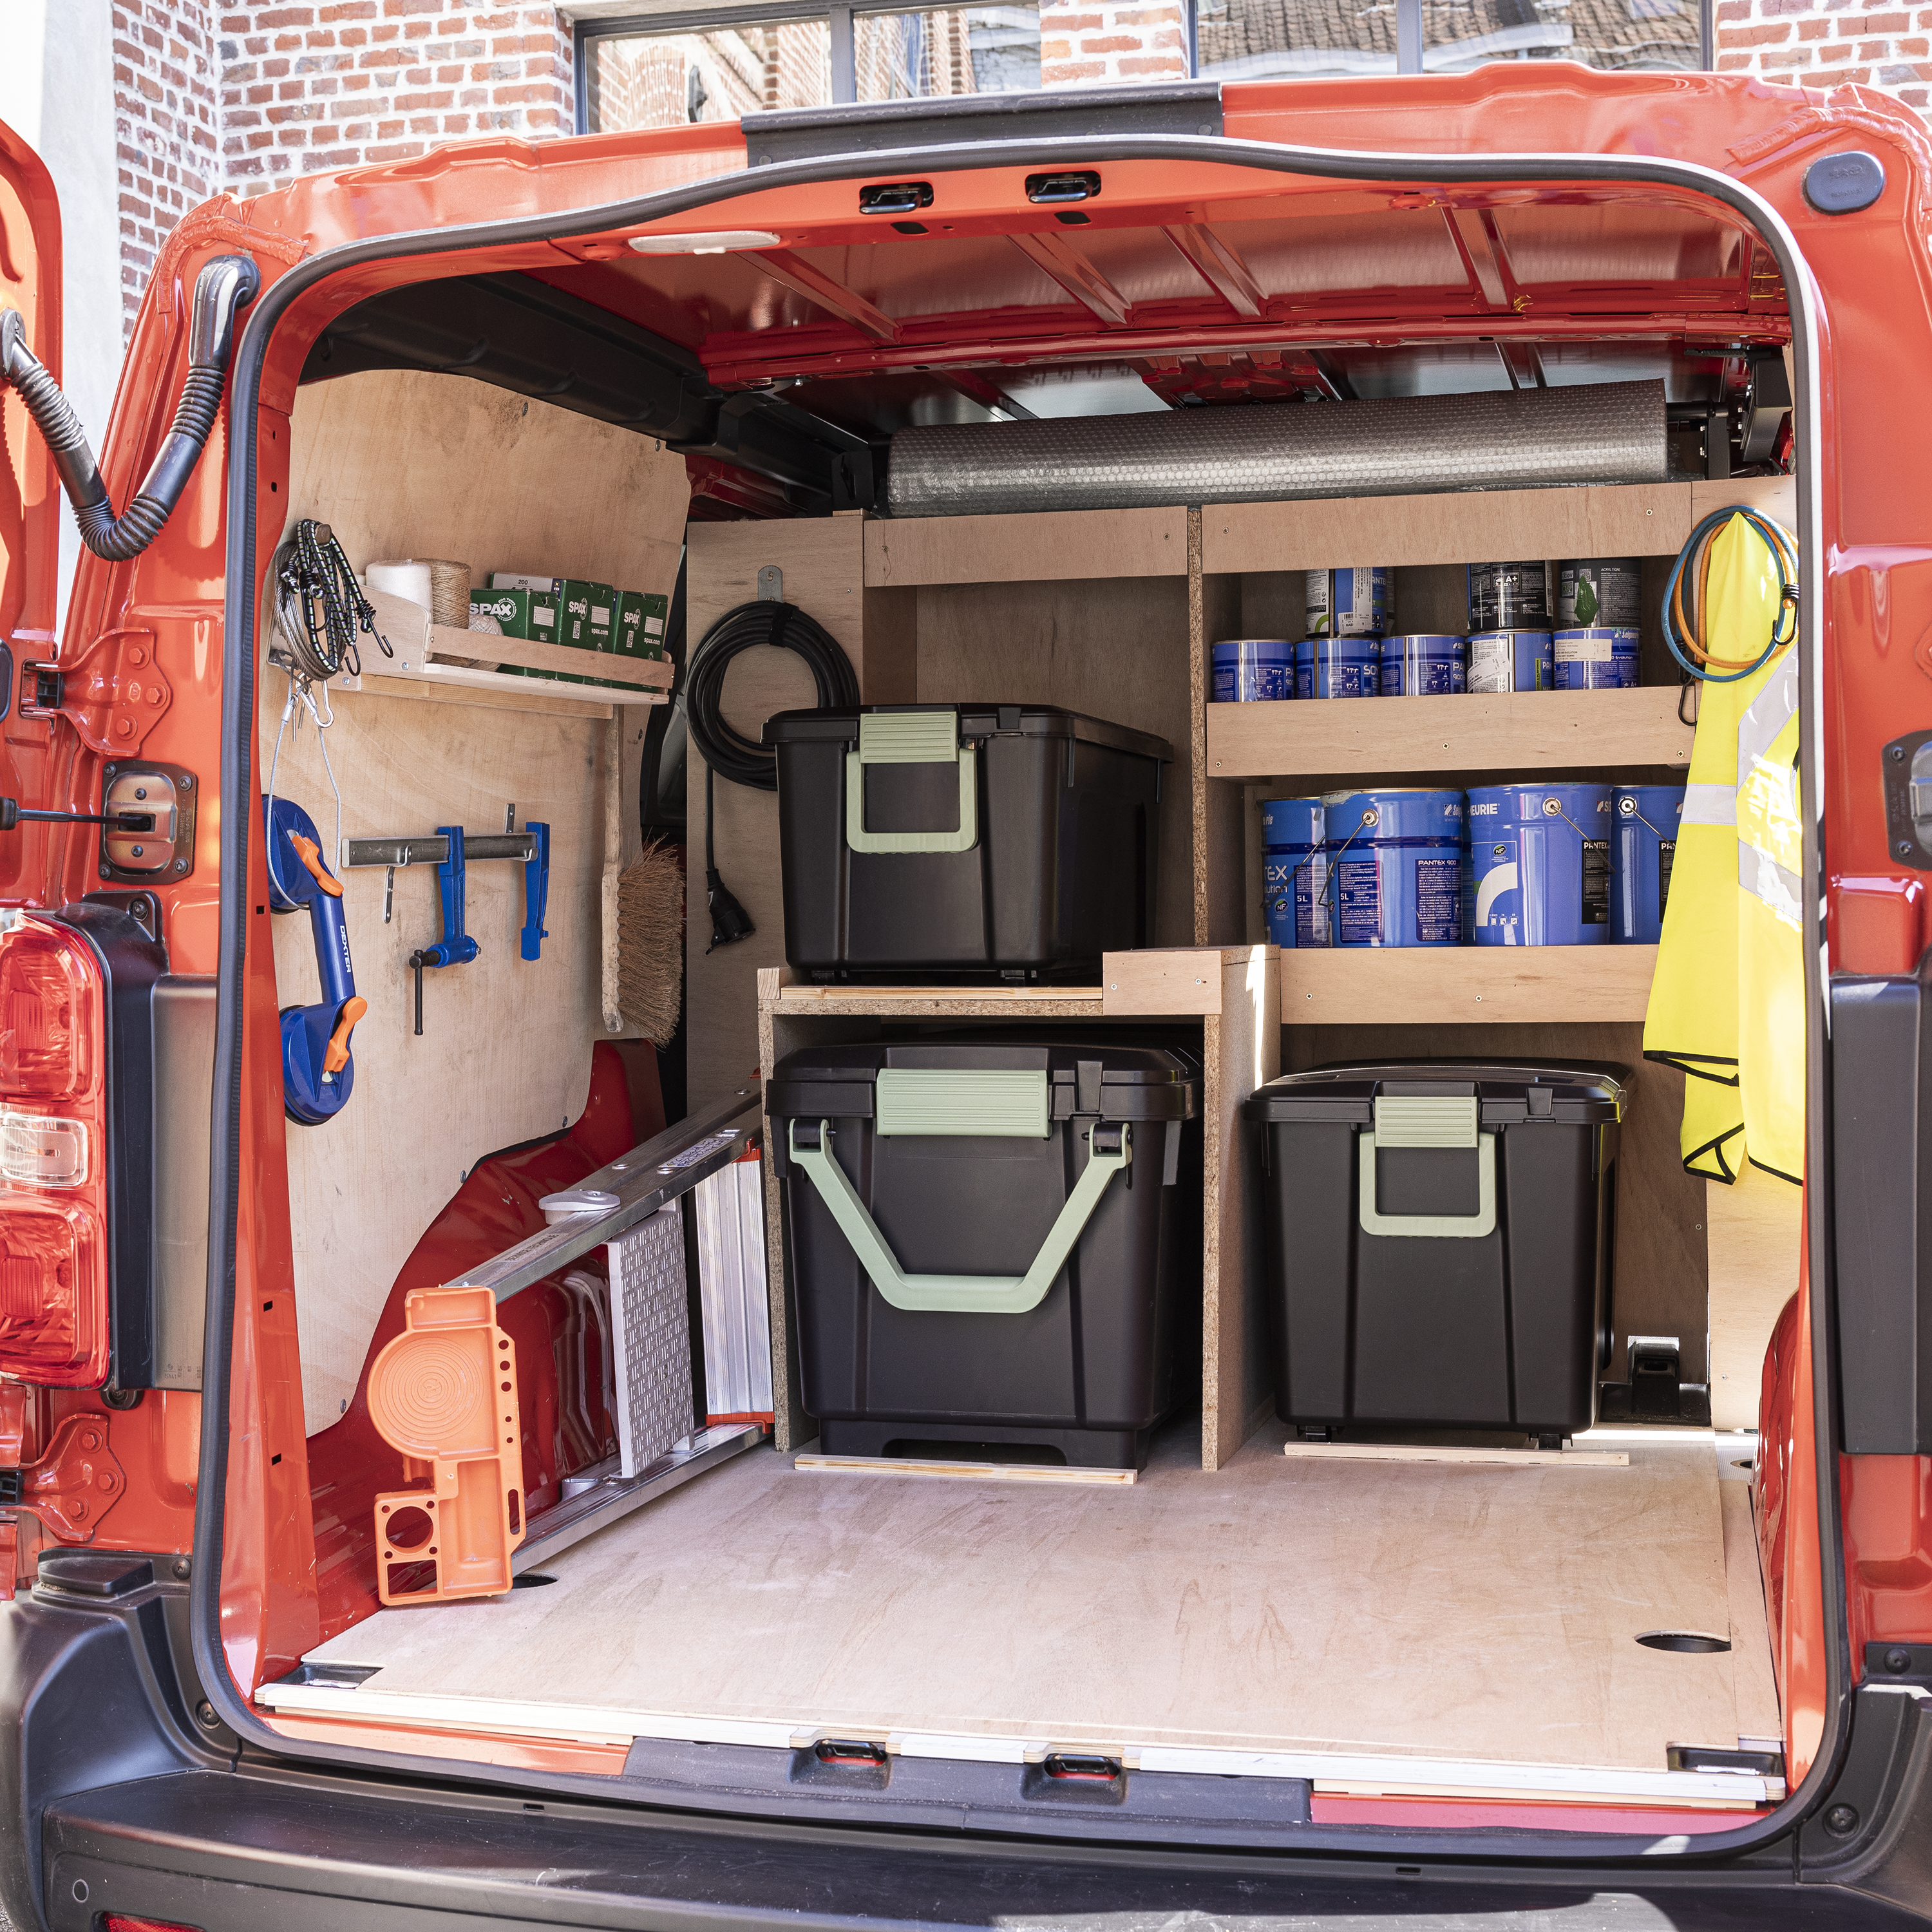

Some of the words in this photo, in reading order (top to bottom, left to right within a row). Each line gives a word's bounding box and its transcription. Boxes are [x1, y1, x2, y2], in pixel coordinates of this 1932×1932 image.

[469, 603, 512, 616] SPAX
[569, 601, 585, 614] SPAX
[624, 612, 639, 625] SPAX
[340, 925, 352, 972] DEXTER
